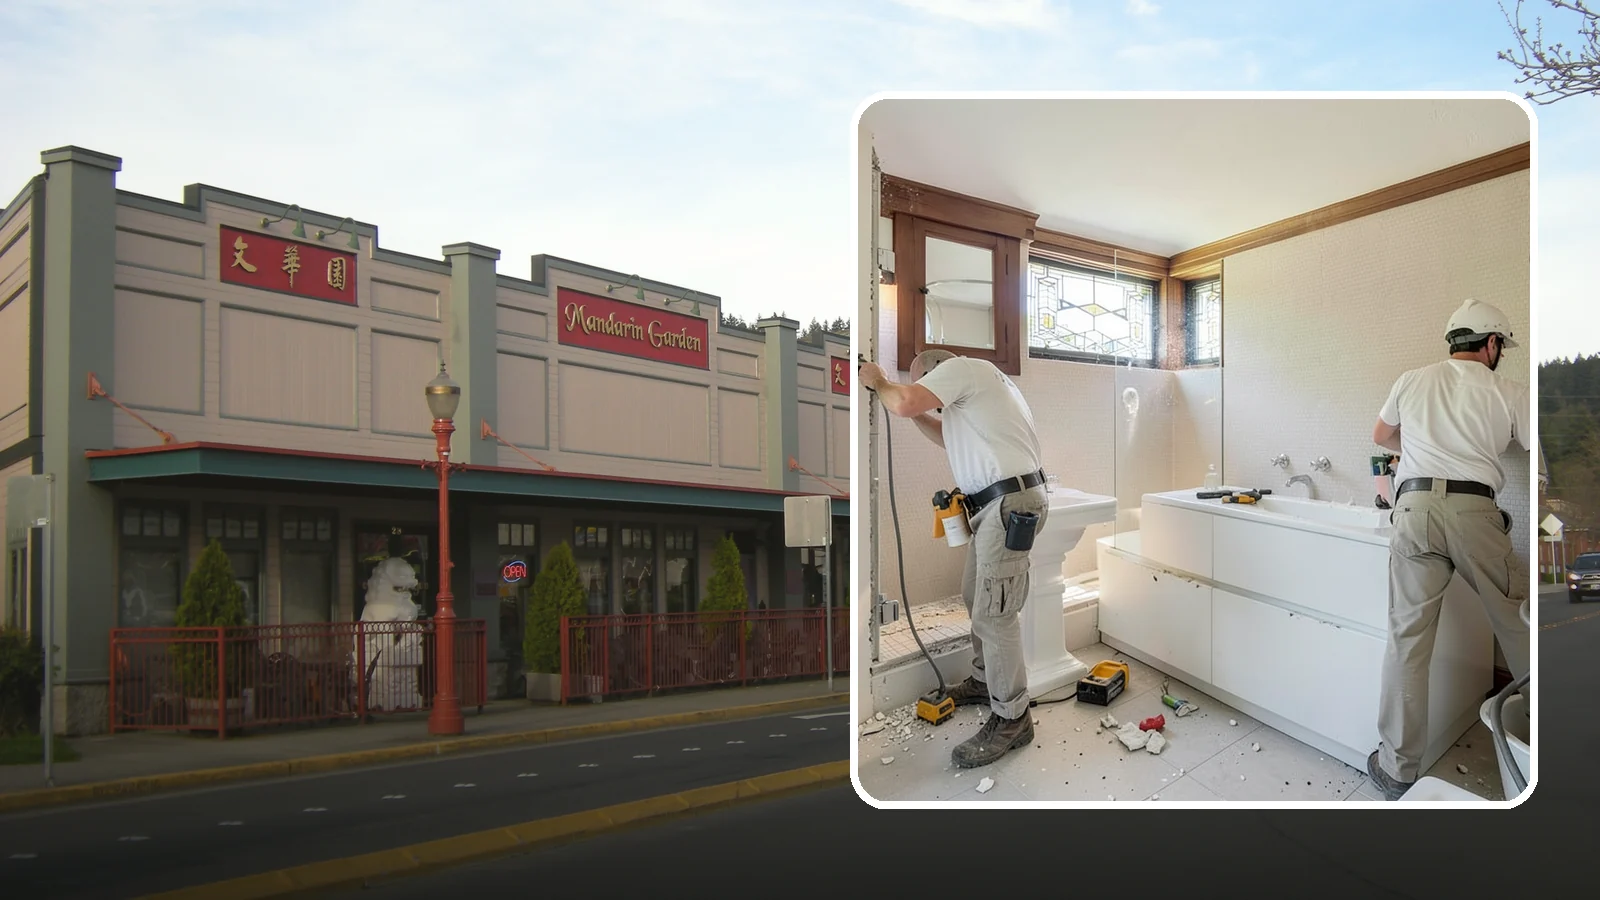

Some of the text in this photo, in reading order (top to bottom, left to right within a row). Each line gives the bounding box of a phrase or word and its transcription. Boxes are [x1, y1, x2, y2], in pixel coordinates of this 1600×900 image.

[565, 303, 701, 351] Mandarin Garden
[503, 565, 527, 578] OPEN
